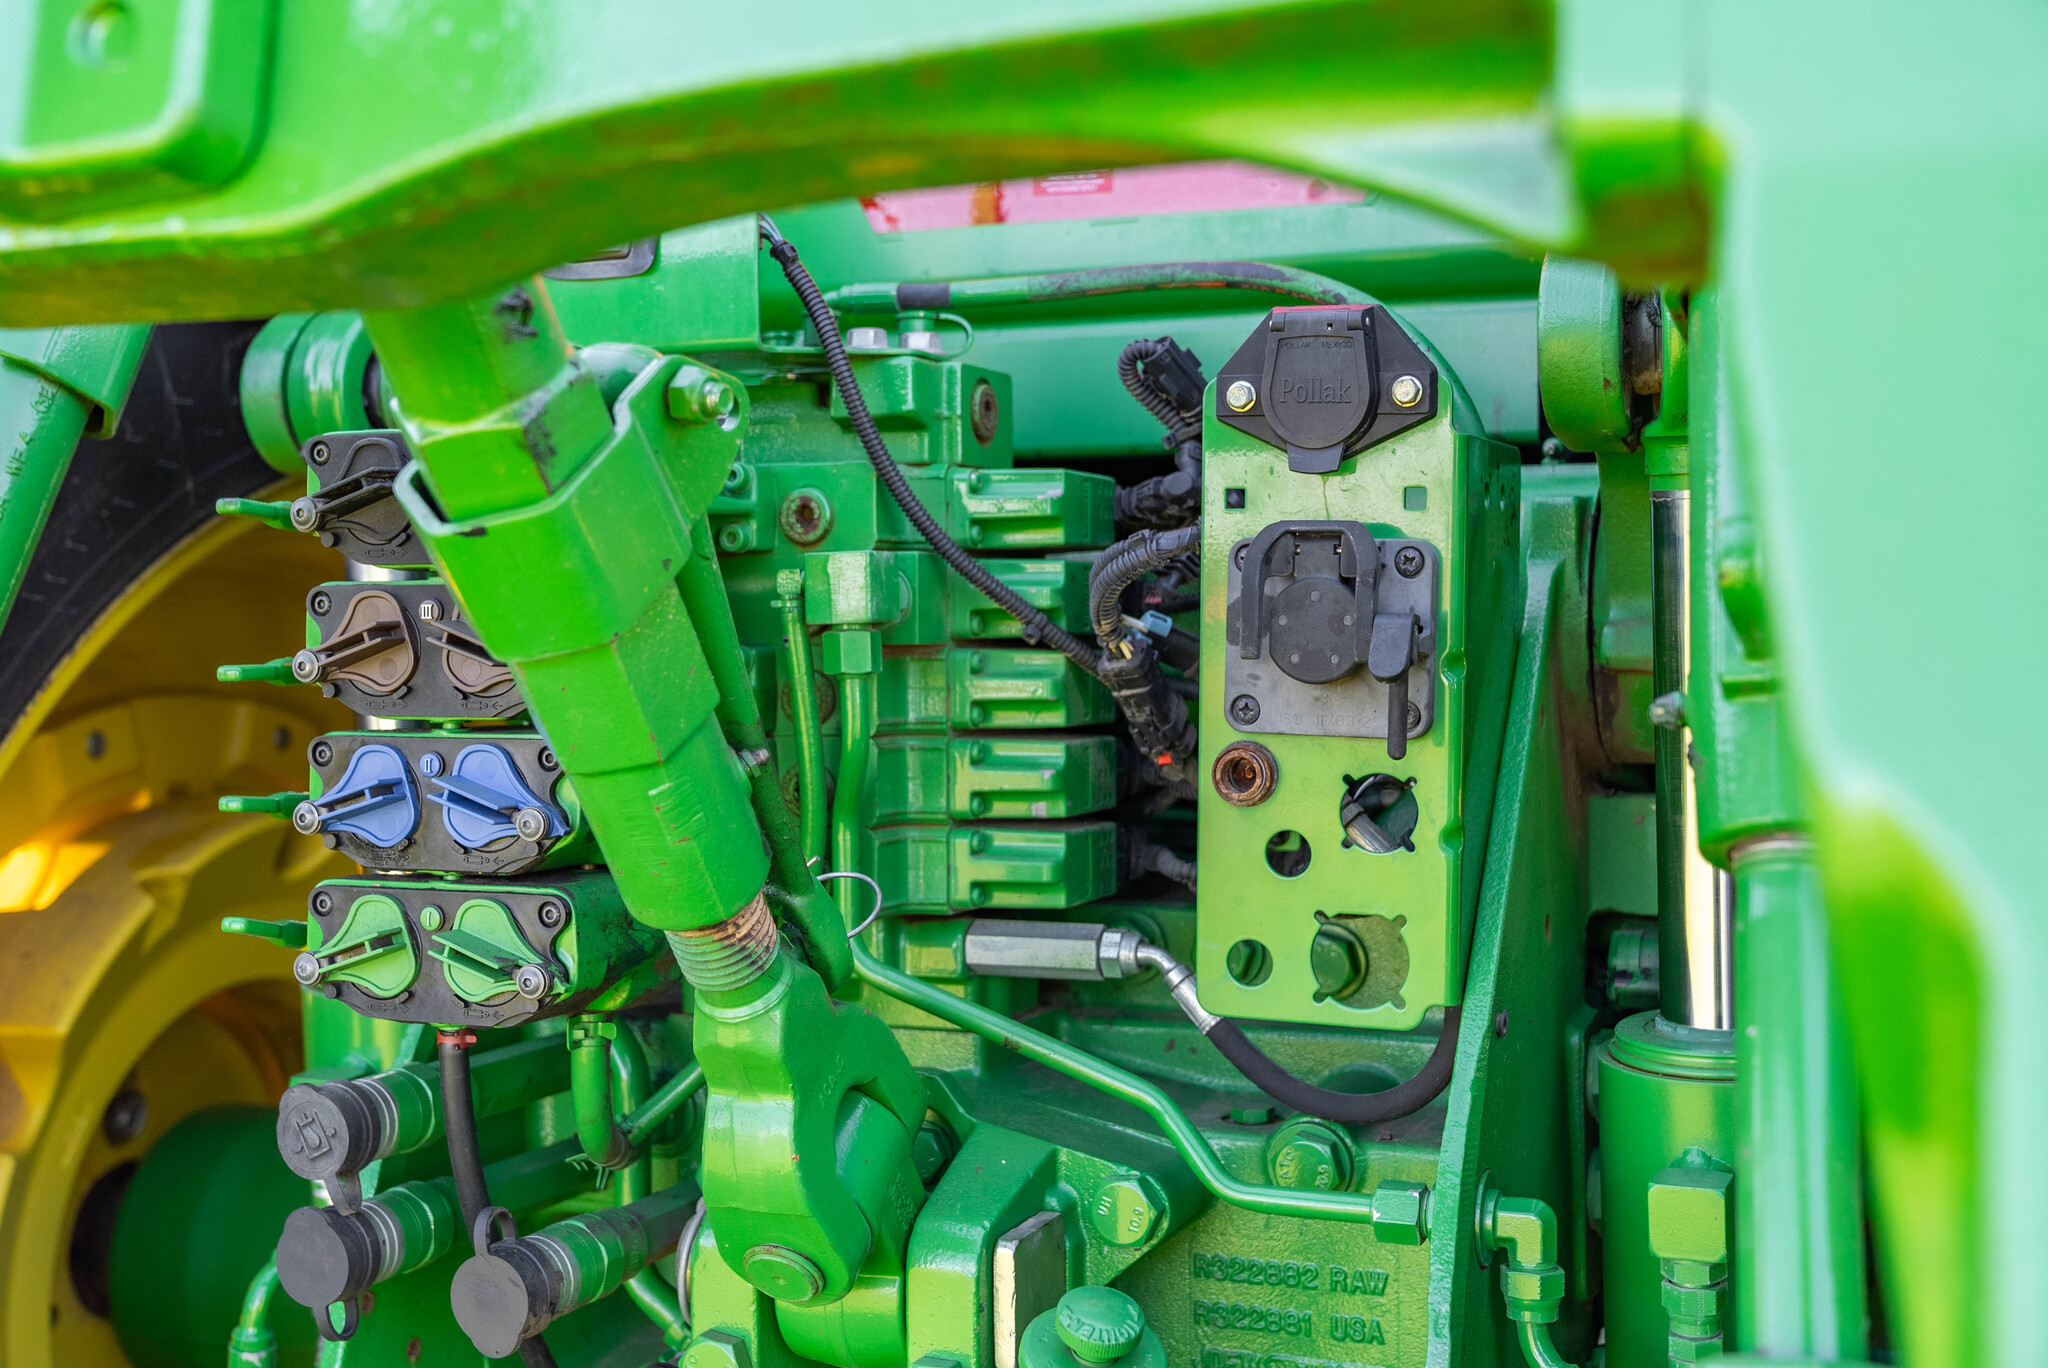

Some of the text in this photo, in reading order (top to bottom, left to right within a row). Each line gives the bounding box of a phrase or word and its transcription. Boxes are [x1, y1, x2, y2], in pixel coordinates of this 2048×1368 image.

[1279, 376, 1352, 405] Pollak
[1128, 1207, 1145, 1233] 10.9
[1193, 1252, 1389, 1297] R322882 RAW
[1193, 1299, 1386, 1345] R322881 USA
